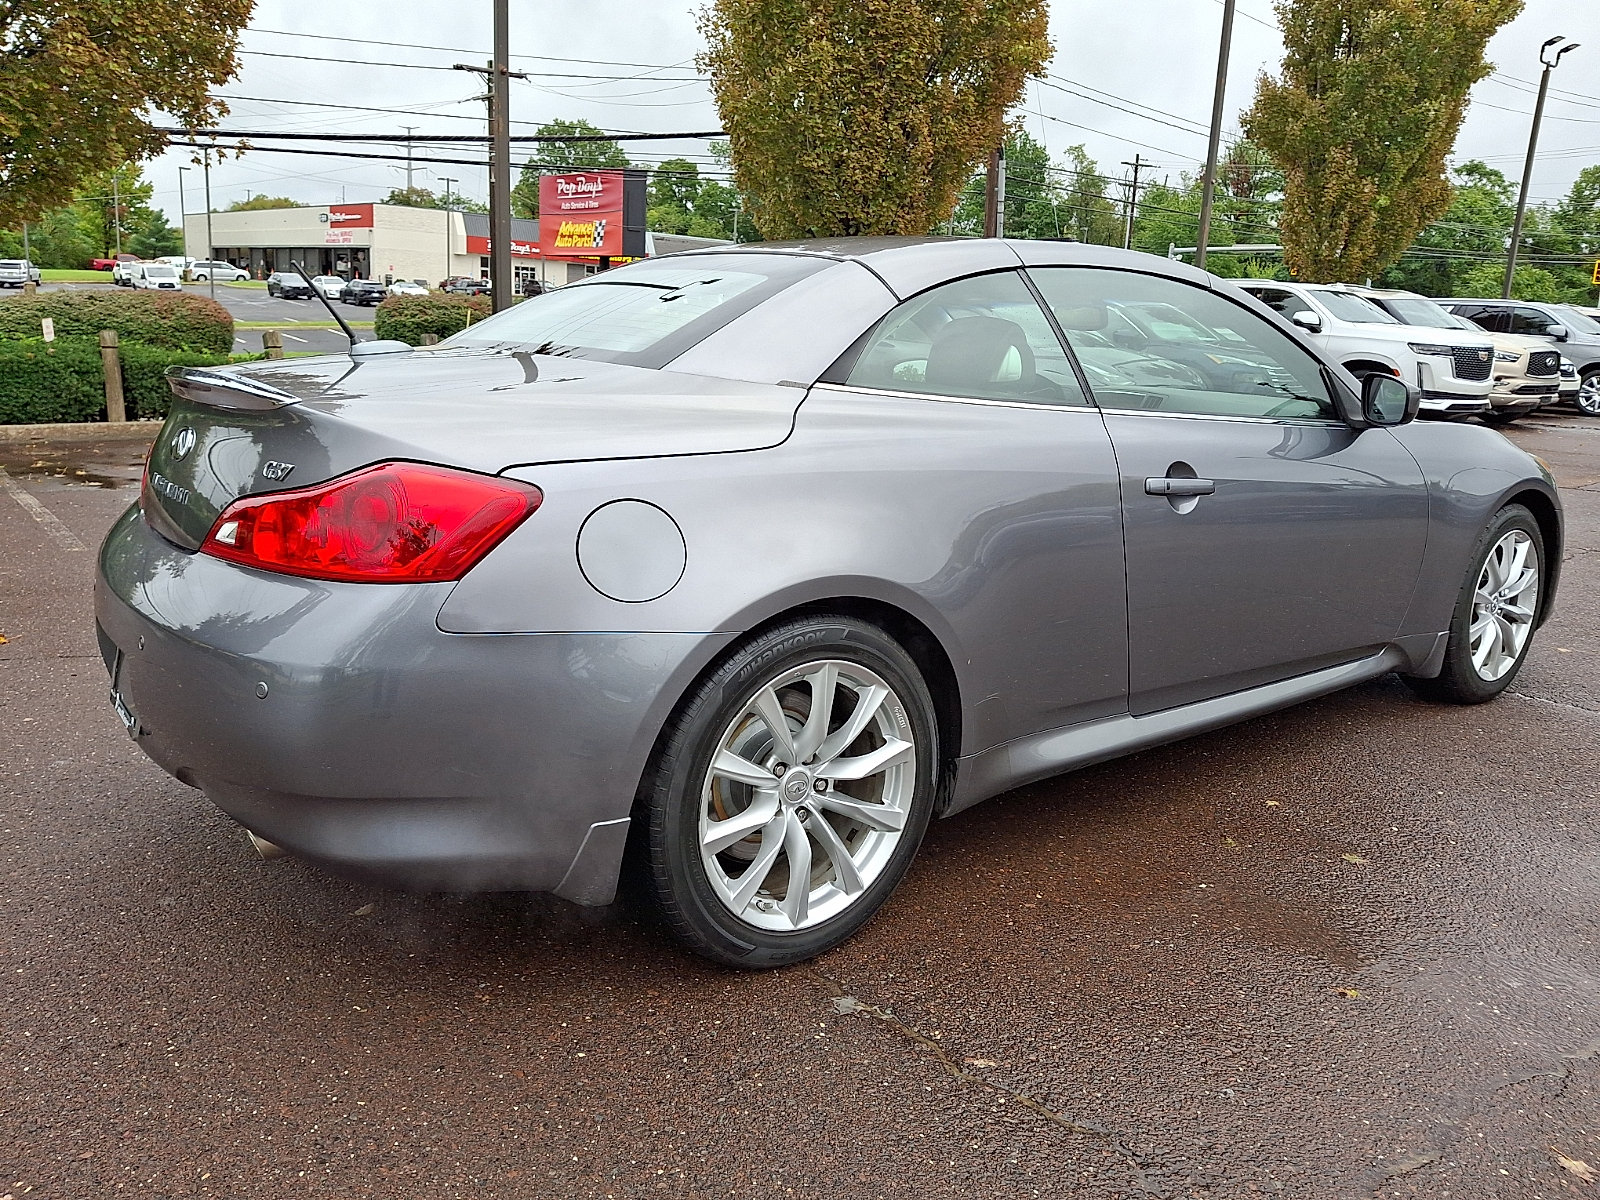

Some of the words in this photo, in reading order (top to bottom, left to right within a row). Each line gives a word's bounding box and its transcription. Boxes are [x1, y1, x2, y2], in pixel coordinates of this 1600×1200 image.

[556, 178, 577, 197] Pep
[576, 175, 603, 198] Boys
[561, 202, 570, 210] Auto
[559, 220, 592, 236] Advance
[554, 236, 573, 247] Auto
[572, 235, 592, 247] Parts
[262, 461, 296, 482] G37
